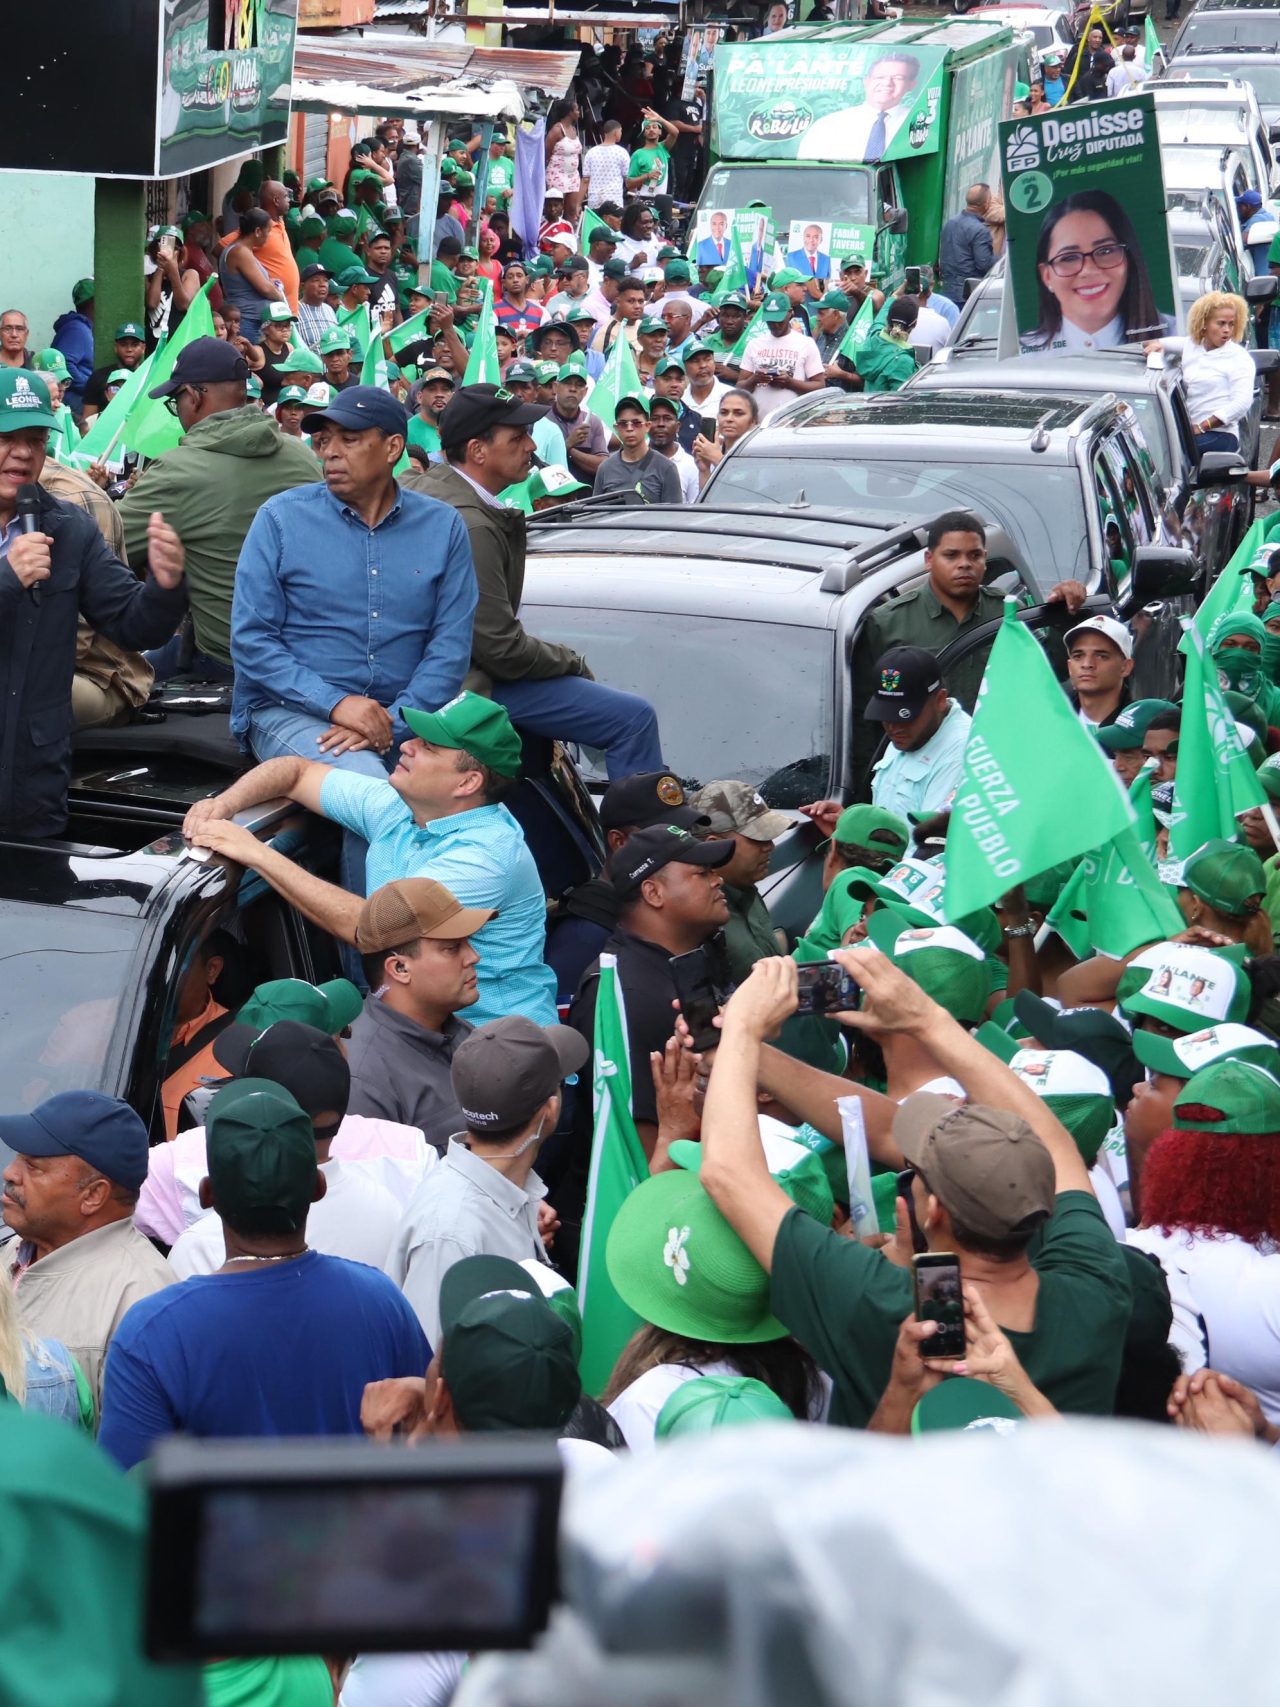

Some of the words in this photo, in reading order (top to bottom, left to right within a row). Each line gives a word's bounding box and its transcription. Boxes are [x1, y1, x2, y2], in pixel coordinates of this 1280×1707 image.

[782, 78, 848, 93] PRESIDENTE
[925, 99, 938, 125] 3
[1041, 108, 1144, 147] Denisse
[1046, 141, 1086, 162] Cruz
[1086, 132, 1145, 155] DIPUTADA
[1010, 157, 1037, 170] FP
[1023, 184, 1042, 209] 2
[832, 228, 861, 239] FABIÁN
[832, 238, 865, 250] TAVERAS
[1053, 340, 1067, 348] SDE
[757, 349, 800, 360] HOLLISTER
[5, 396, 42, 406] LEONEL
[967, 735, 1021, 817] FUERZA
[956, 793, 1022, 878] PUEBLO
